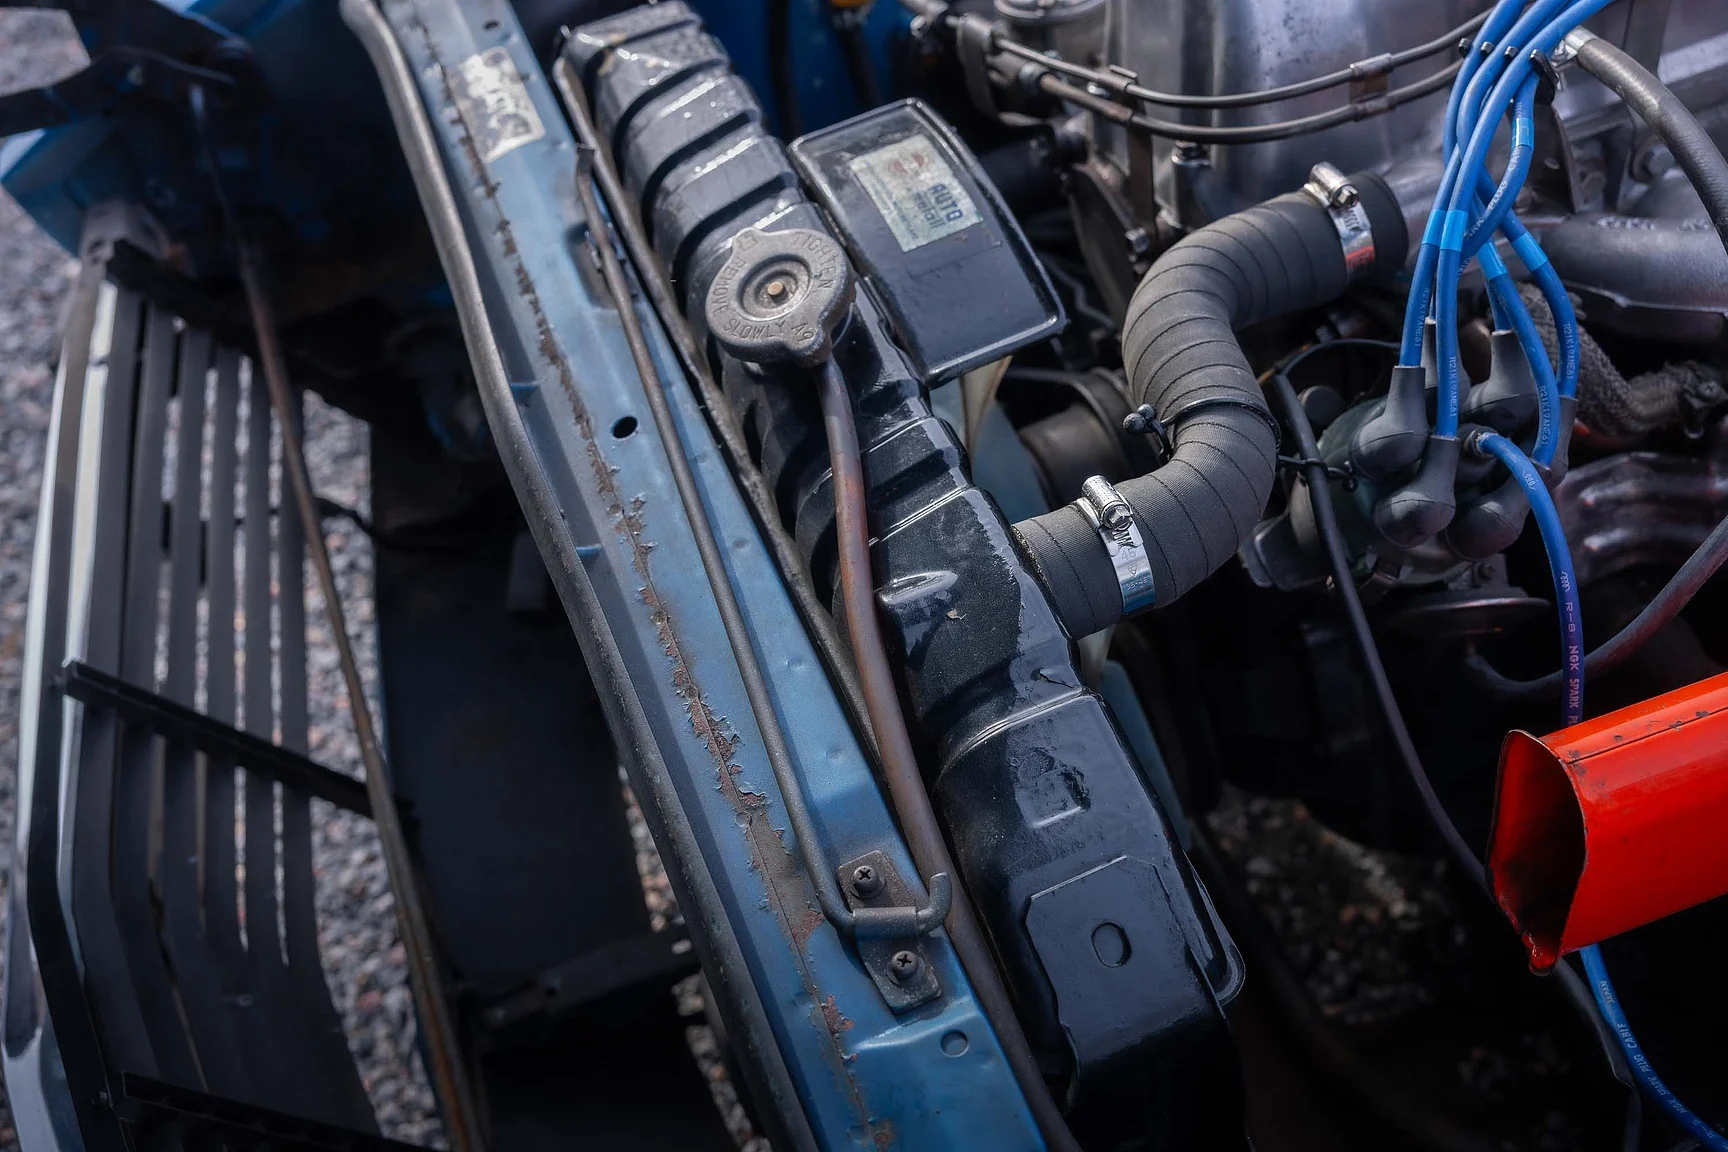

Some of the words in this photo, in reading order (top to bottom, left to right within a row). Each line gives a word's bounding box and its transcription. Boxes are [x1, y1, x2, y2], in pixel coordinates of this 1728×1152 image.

[928, 184, 963, 221] AUTO
[1487, 181, 1508, 212] PLUG
[792, 231, 838, 290] TIGHTEN
[711, 257, 747, 317] REMOVE
[723, 318, 786, 340] SLOWLY
[1568, 645, 1580, 671] NGK
[1568, 678, 1580, 708] SPARK
[1600, 980, 1616, 1004] JAPAN
[1616, 1023, 1638, 1049] CABLE
[1633, 1054, 1653, 1072] PLUG
[1648, 1076, 1670, 1096] SPARK
